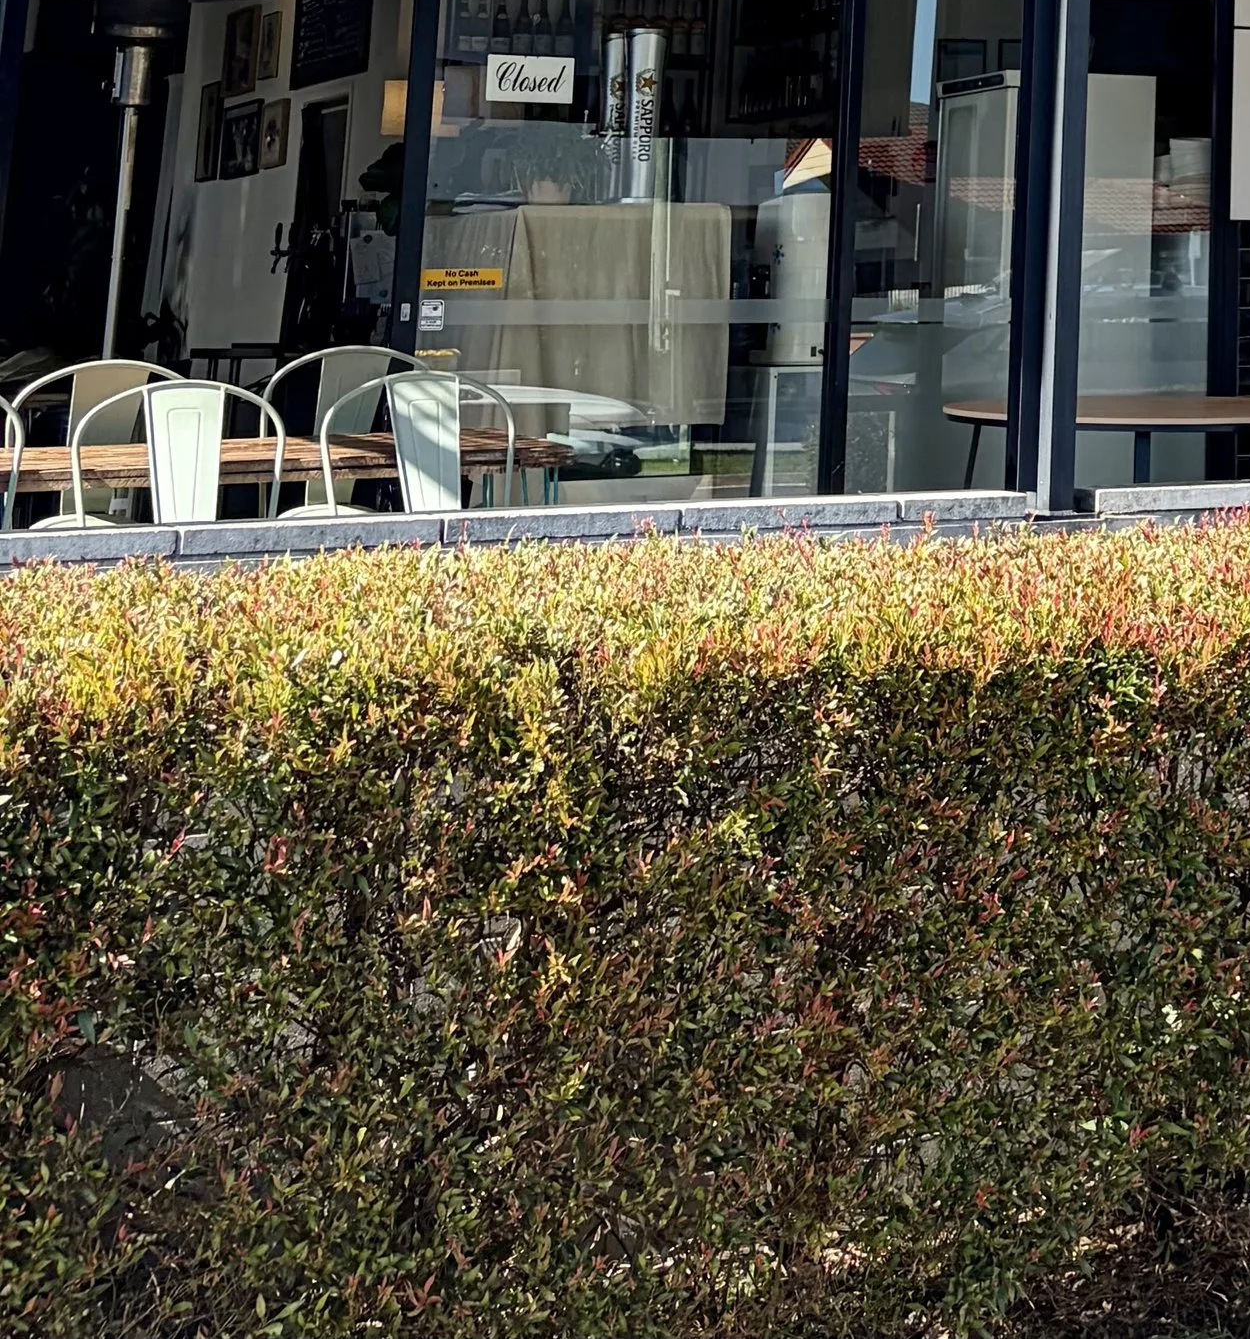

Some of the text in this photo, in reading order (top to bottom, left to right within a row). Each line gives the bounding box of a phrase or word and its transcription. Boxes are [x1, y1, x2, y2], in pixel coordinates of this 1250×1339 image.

[495, 61, 567, 93] Closed
[637, 99, 655, 162] SAPPORO
[427, 279, 446, 287] Kept
[459, 278, 496, 286] Premises
